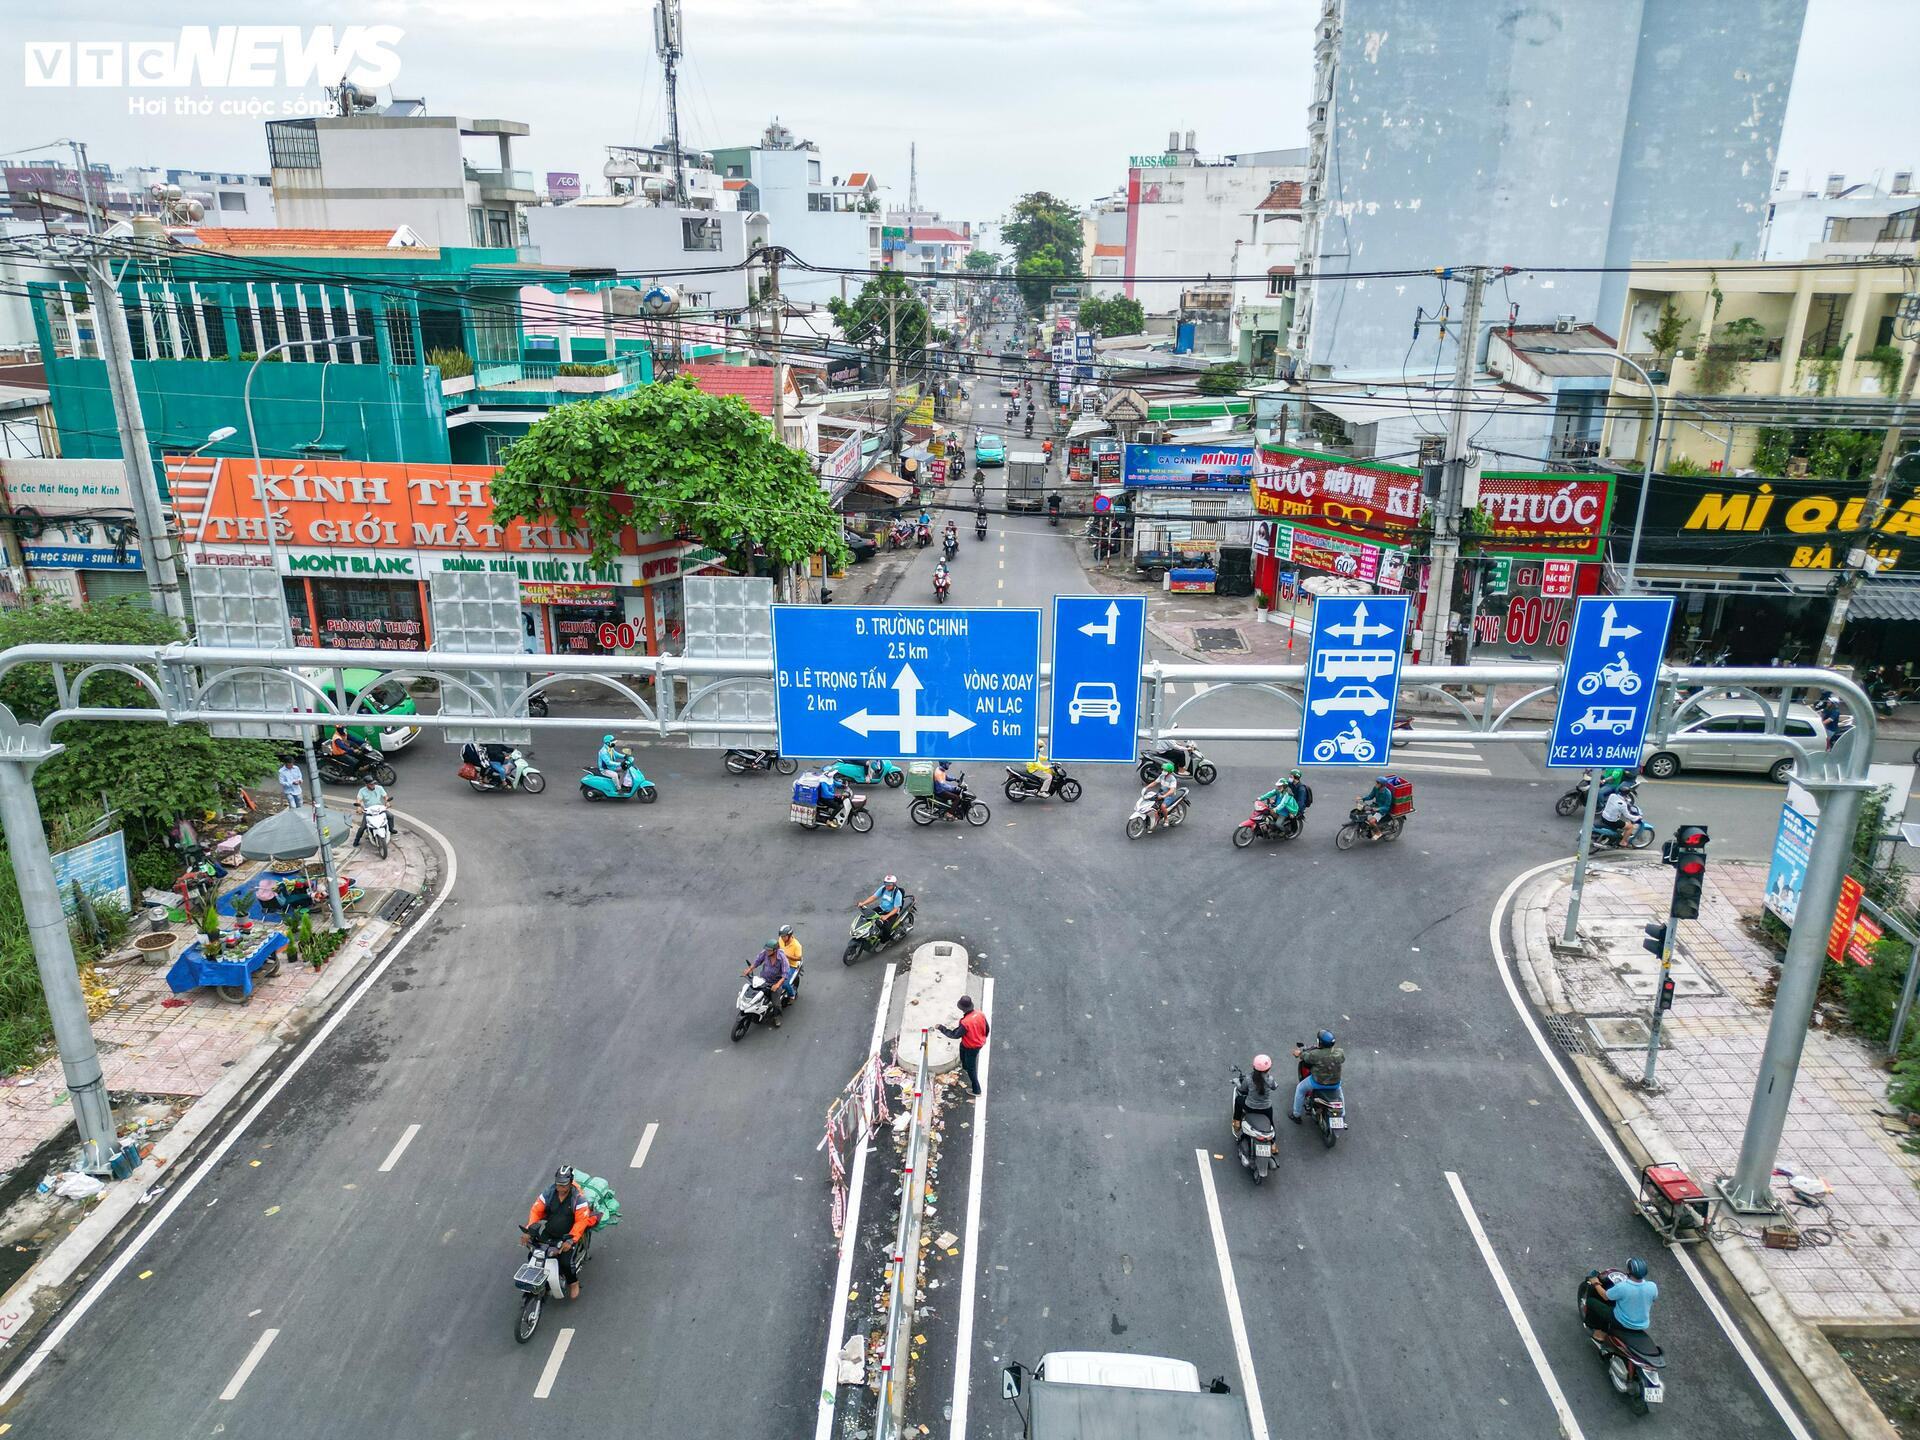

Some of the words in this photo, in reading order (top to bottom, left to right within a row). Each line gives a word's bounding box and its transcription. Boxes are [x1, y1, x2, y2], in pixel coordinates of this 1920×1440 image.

[1129, 155, 1178, 168] MASSAGE
[1200, 453, 1239, 466] MINH
[248, 464, 391, 504] KÍNH
[1323, 467, 1351, 495] SIÊU
[1353, 475, 1378, 503] THỊ
[1282, 499, 1313, 516] PHỦ
[1480, 482, 1598, 525] THUỐC
[1684, 483, 1776, 531] MÌ
[208, 507, 295, 542] THẾ
[309, 512, 399, 544] GIỚI
[412, 511, 505, 547] MẮT
[41, 553, 59, 564] HỌC
[62, 553, 84, 563] SINH
[92, 554, 113, 564] SINH
[489, 556, 529, 580] KHÁM
[532, 557, 569, 582] KHÚC
[642, 556, 678, 579] OPTIC
[1546, 585, 1555, 593] HS
[1559, 585, 1567, 593] SV
[327, 618, 365, 632] PHÒNG
[367, 619, 381, 632] KỸ
[384, 620, 420, 635] THUẬT
[856, 617, 869, 636] Đ.
[872, 612, 925, 637] TRƯỜNG
[928, 618, 968, 636] CHINH
[1505, 595, 1570, 647] 60%
[348, 636, 376, 649] KHÁM
[888, 642, 906, 660] 2.5
[909, 642, 928, 660] km
[780, 670, 793, 687] Đ.
[796, 666, 812, 688] LÊ
[814, 670, 858, 692] TRỌNG
[859, 666, 887, 689] TẤN
[963, 669, 998, 691] VÒNG
[1001, 674, 1034, 691] XOAY
[807, 695, 815, 711] 2
[816, 694, 837, 712] km
[976, 697, 995, 714] AN
[998, 697, 1023, 719] LẠC
[992, 720, 1000, 736] 6
[1001, 720, 1021, 736] km
[1553, 746, 1568, 758] XE
[1570, 746, 1577, 758] 2
[1580, 743, 1593, 758] VÀ
[1596, 746, 1603, 758] 3
[1605, 744, 1638, 759] BÁNH
